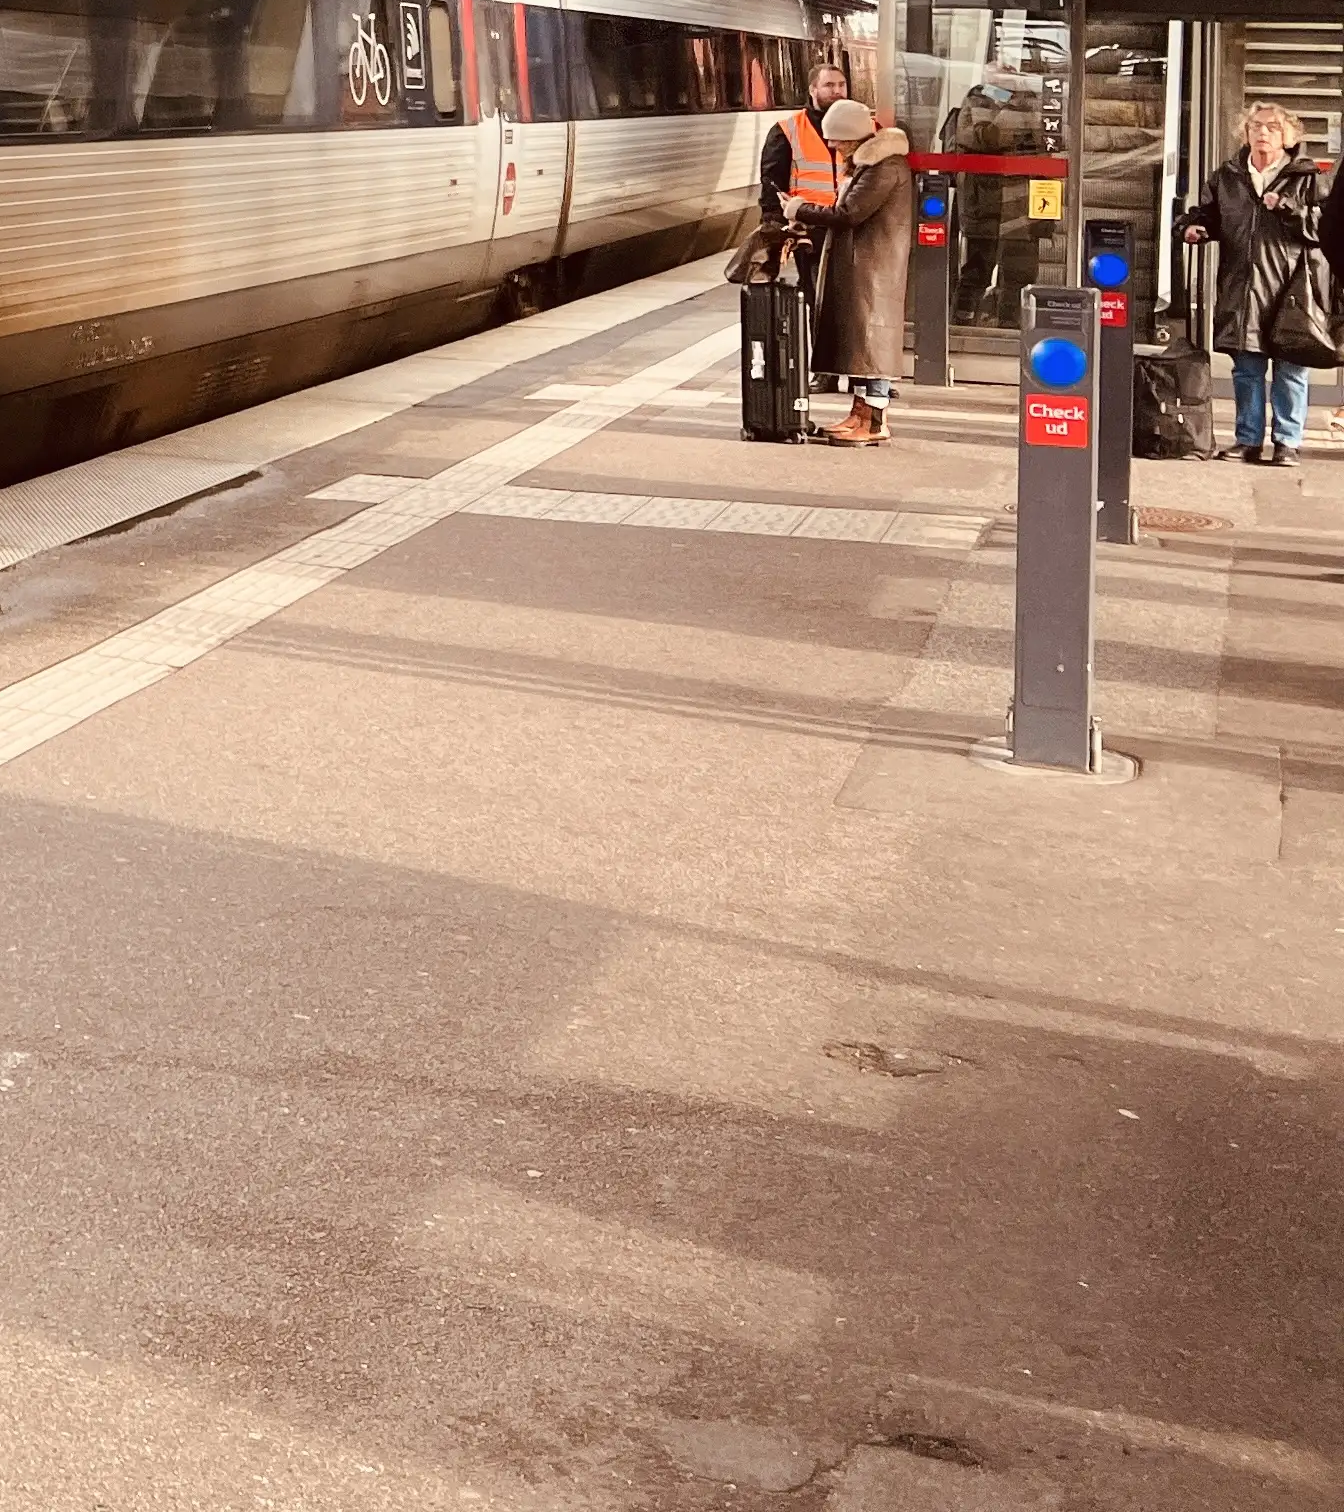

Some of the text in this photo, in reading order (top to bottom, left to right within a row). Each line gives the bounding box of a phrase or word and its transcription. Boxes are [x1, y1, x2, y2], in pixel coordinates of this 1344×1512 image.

[1100, 299, 1125, 310] eck
[1028, 402, 1085, 421] Check
[1044, 421, 1068, 436] ud
